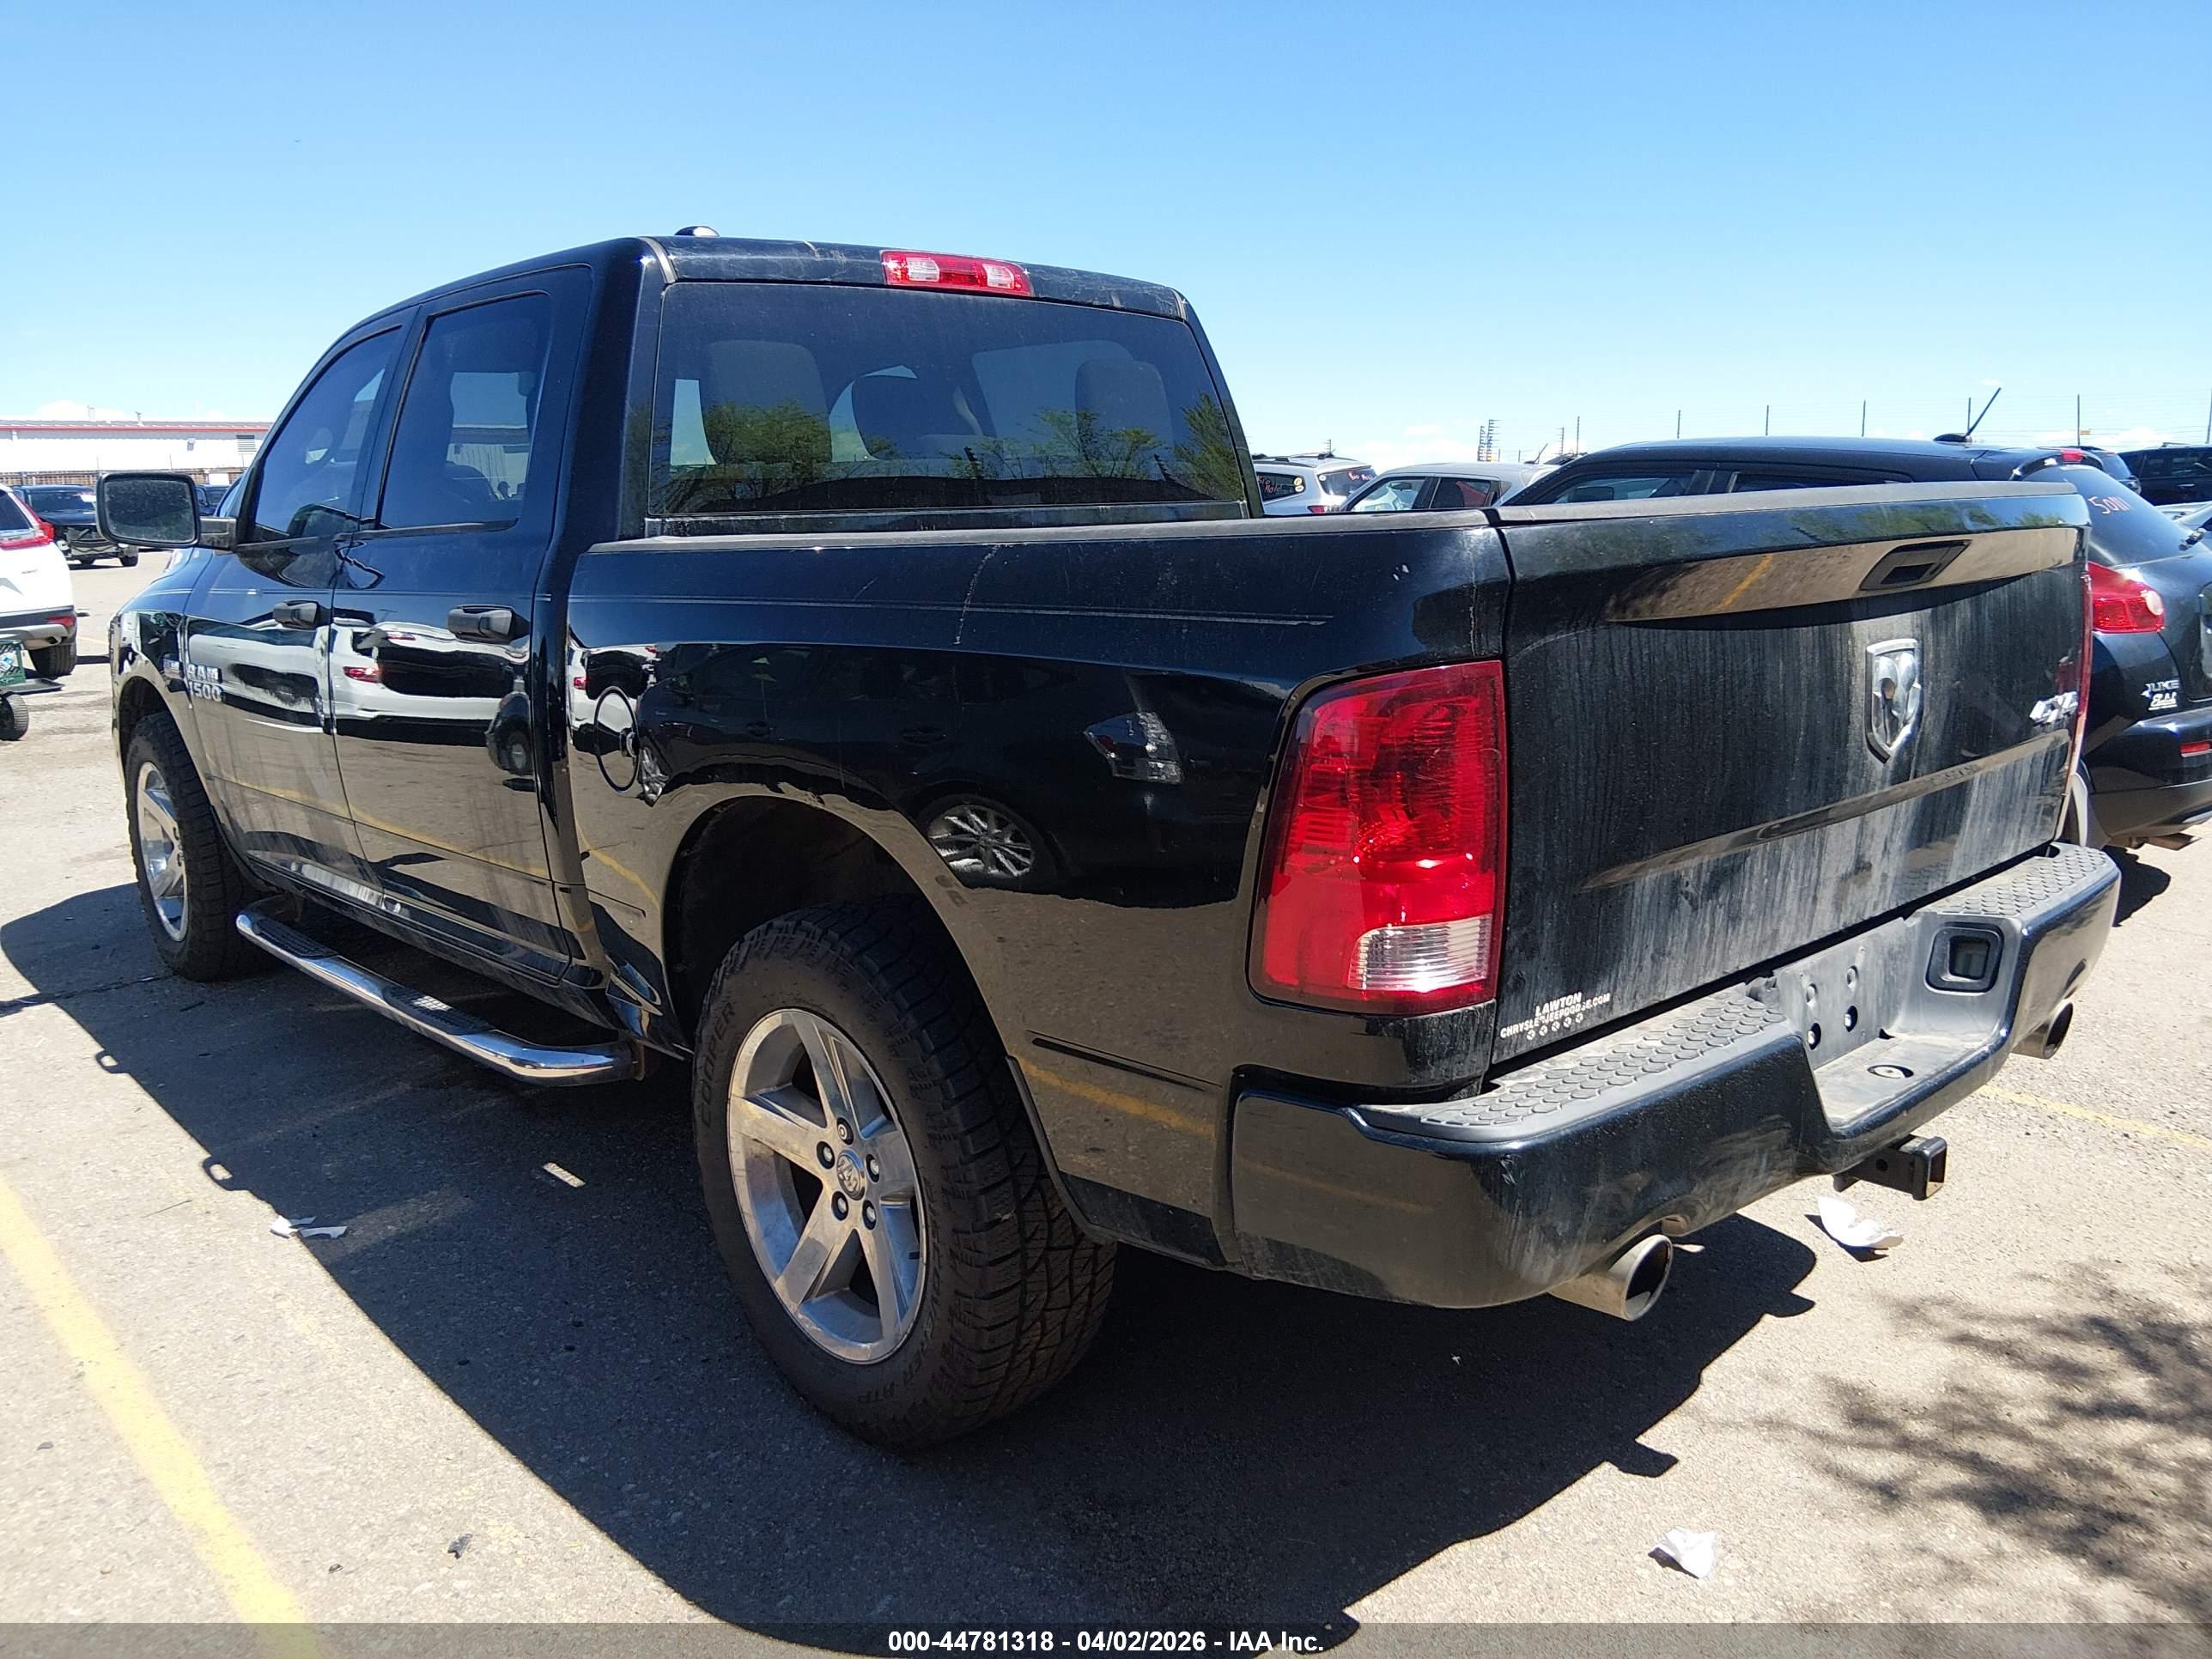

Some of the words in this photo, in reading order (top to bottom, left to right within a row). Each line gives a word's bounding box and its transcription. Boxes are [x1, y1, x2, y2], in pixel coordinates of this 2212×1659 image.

[187, 664, 221, 684] RAM
[188, 681, 223, 702] 1500
[1535, 992, 1583, 1017] LAWTON
[701, 1001, 736, 1129] COOPER
